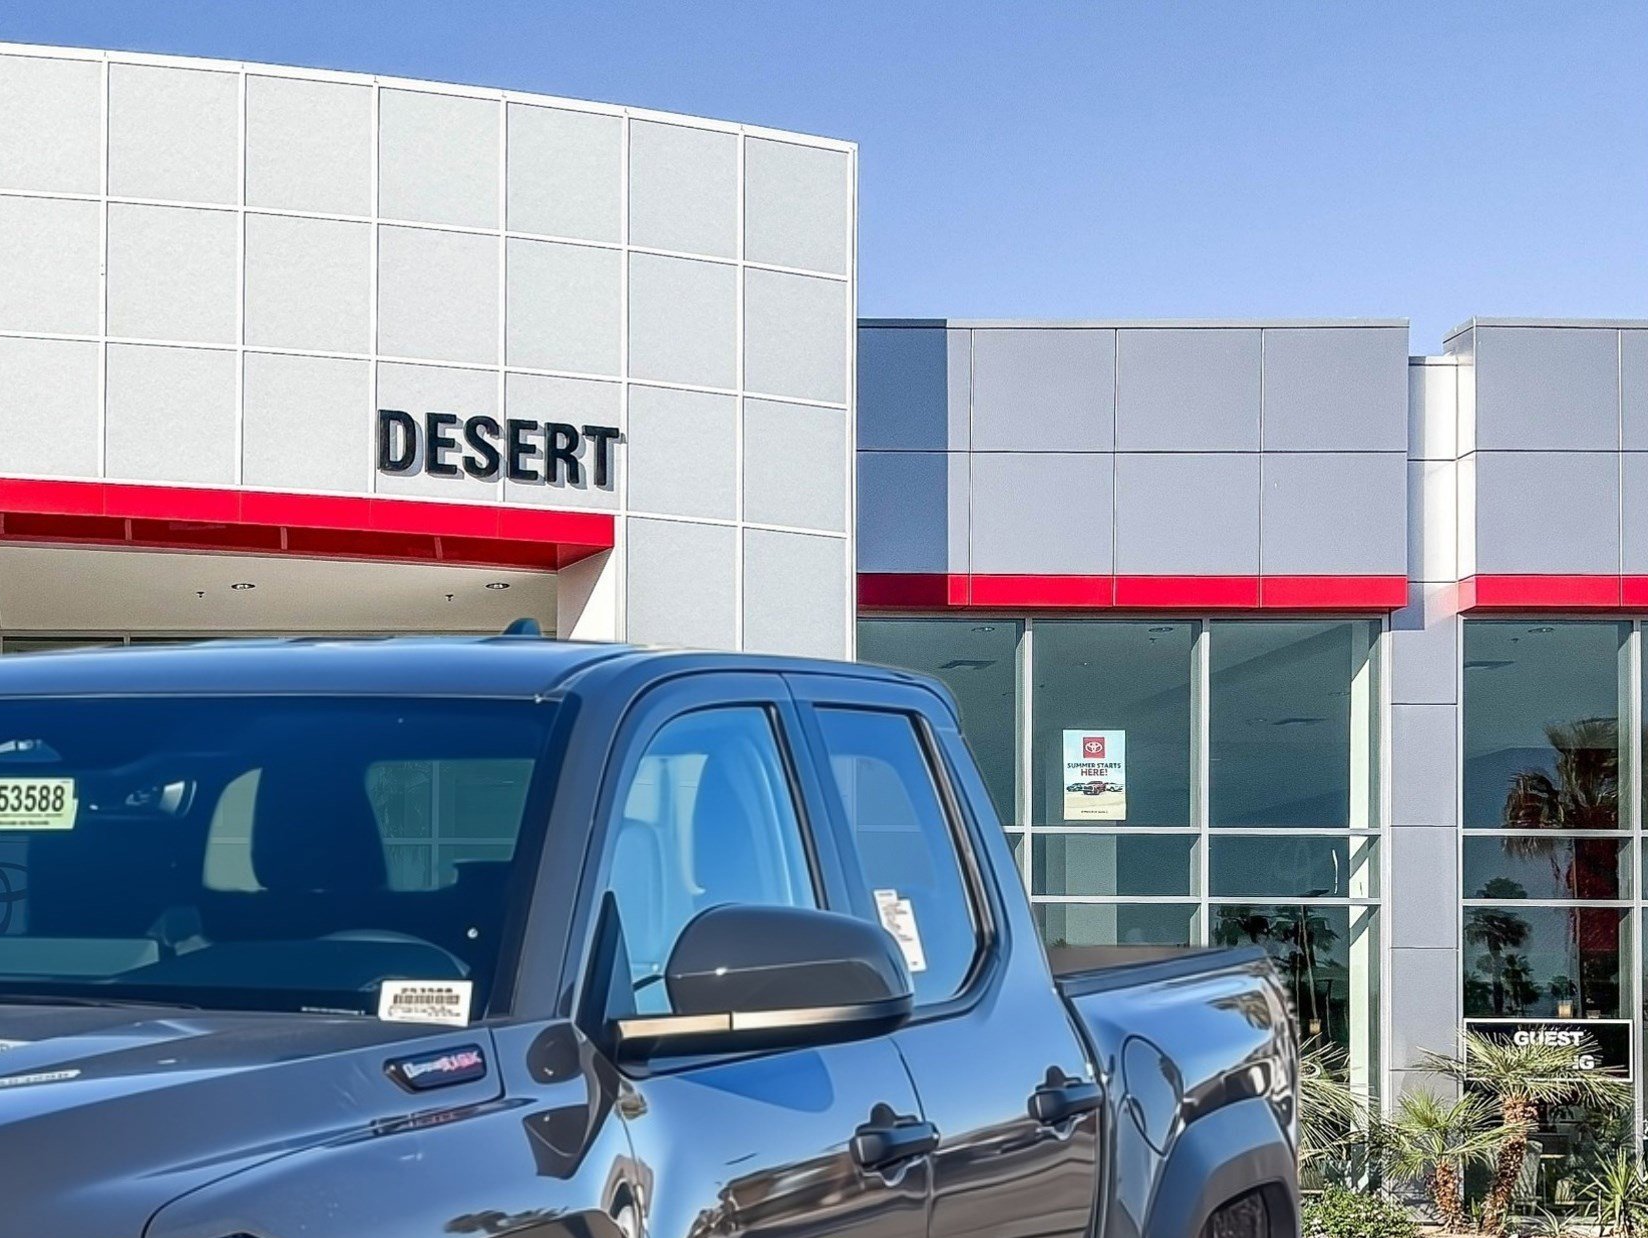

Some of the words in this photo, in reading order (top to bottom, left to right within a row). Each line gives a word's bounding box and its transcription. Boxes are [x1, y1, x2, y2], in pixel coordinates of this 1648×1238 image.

[376, 409, 620, 487] DESERT
[1080, 768, 1108, 776] HERE!
[1513, 1030, 1584, 1047] GUEST
